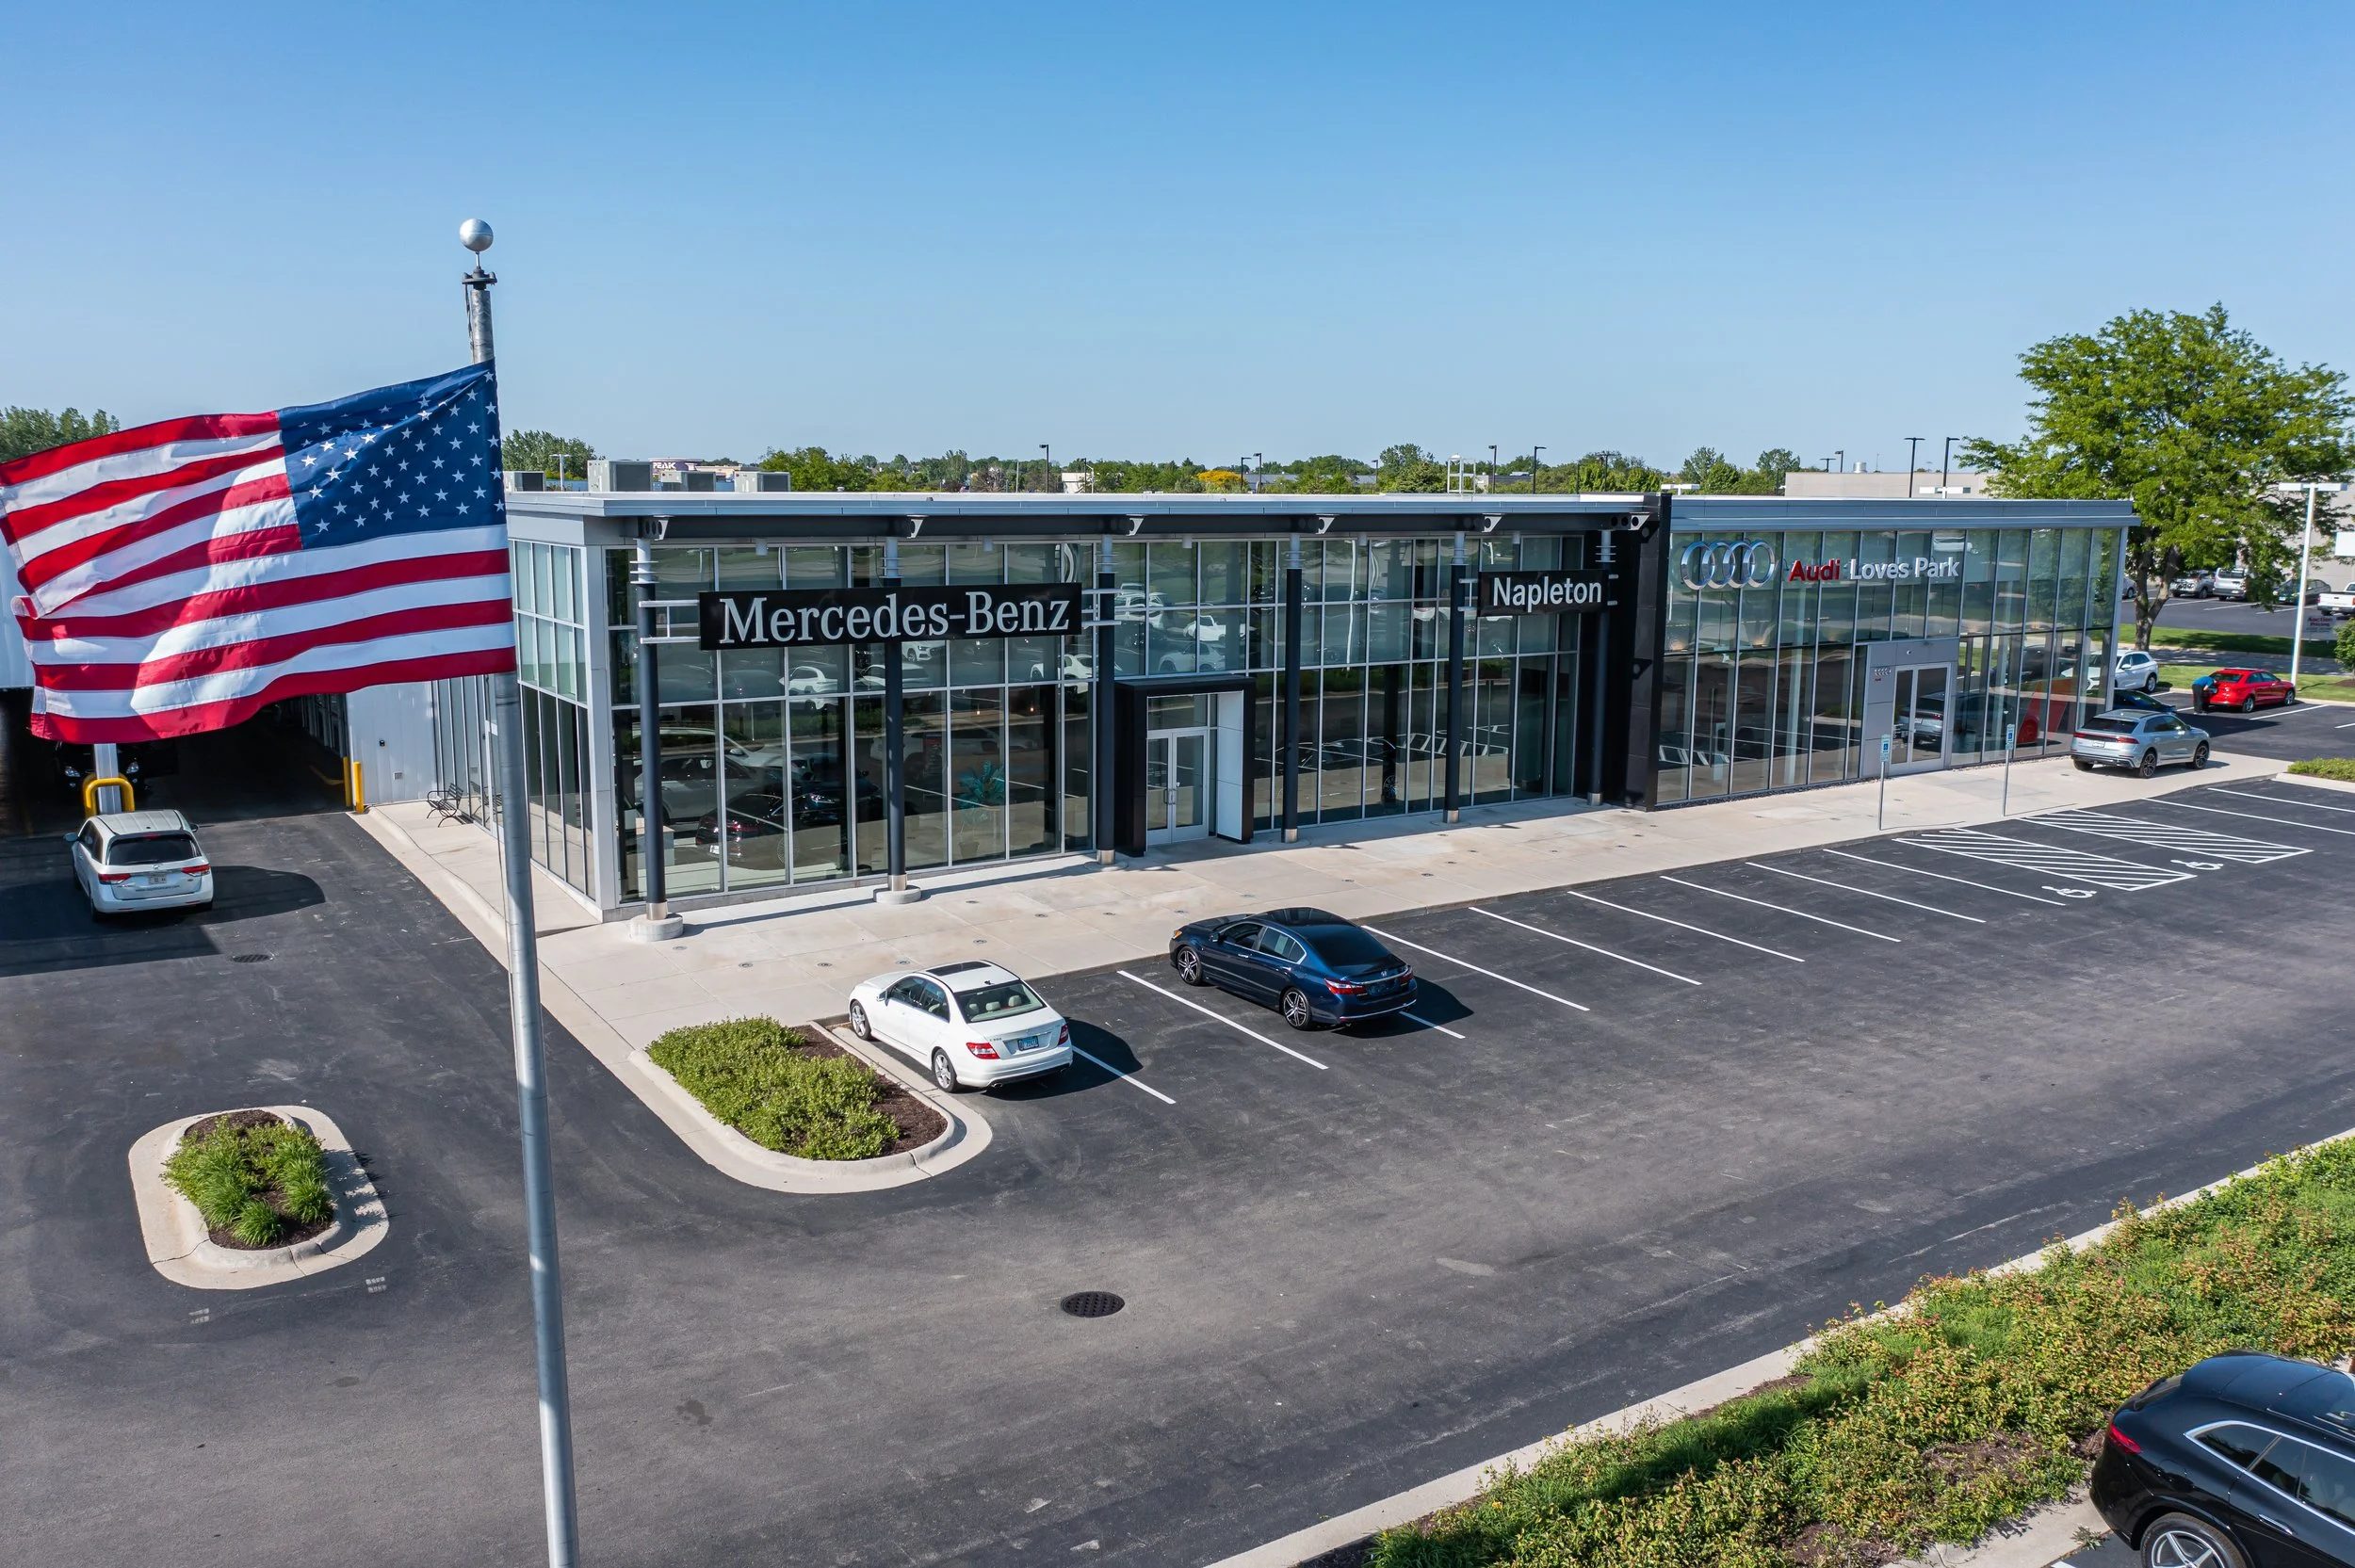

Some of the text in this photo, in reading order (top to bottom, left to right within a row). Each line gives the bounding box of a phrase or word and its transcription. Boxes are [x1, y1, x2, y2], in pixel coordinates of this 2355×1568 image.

[1789, 557, 1959, 581] Audi Loves Park
[1493, 575, 1601, 613] Napleton
[719, 590, 1070, 645] Mercedes-Benz
